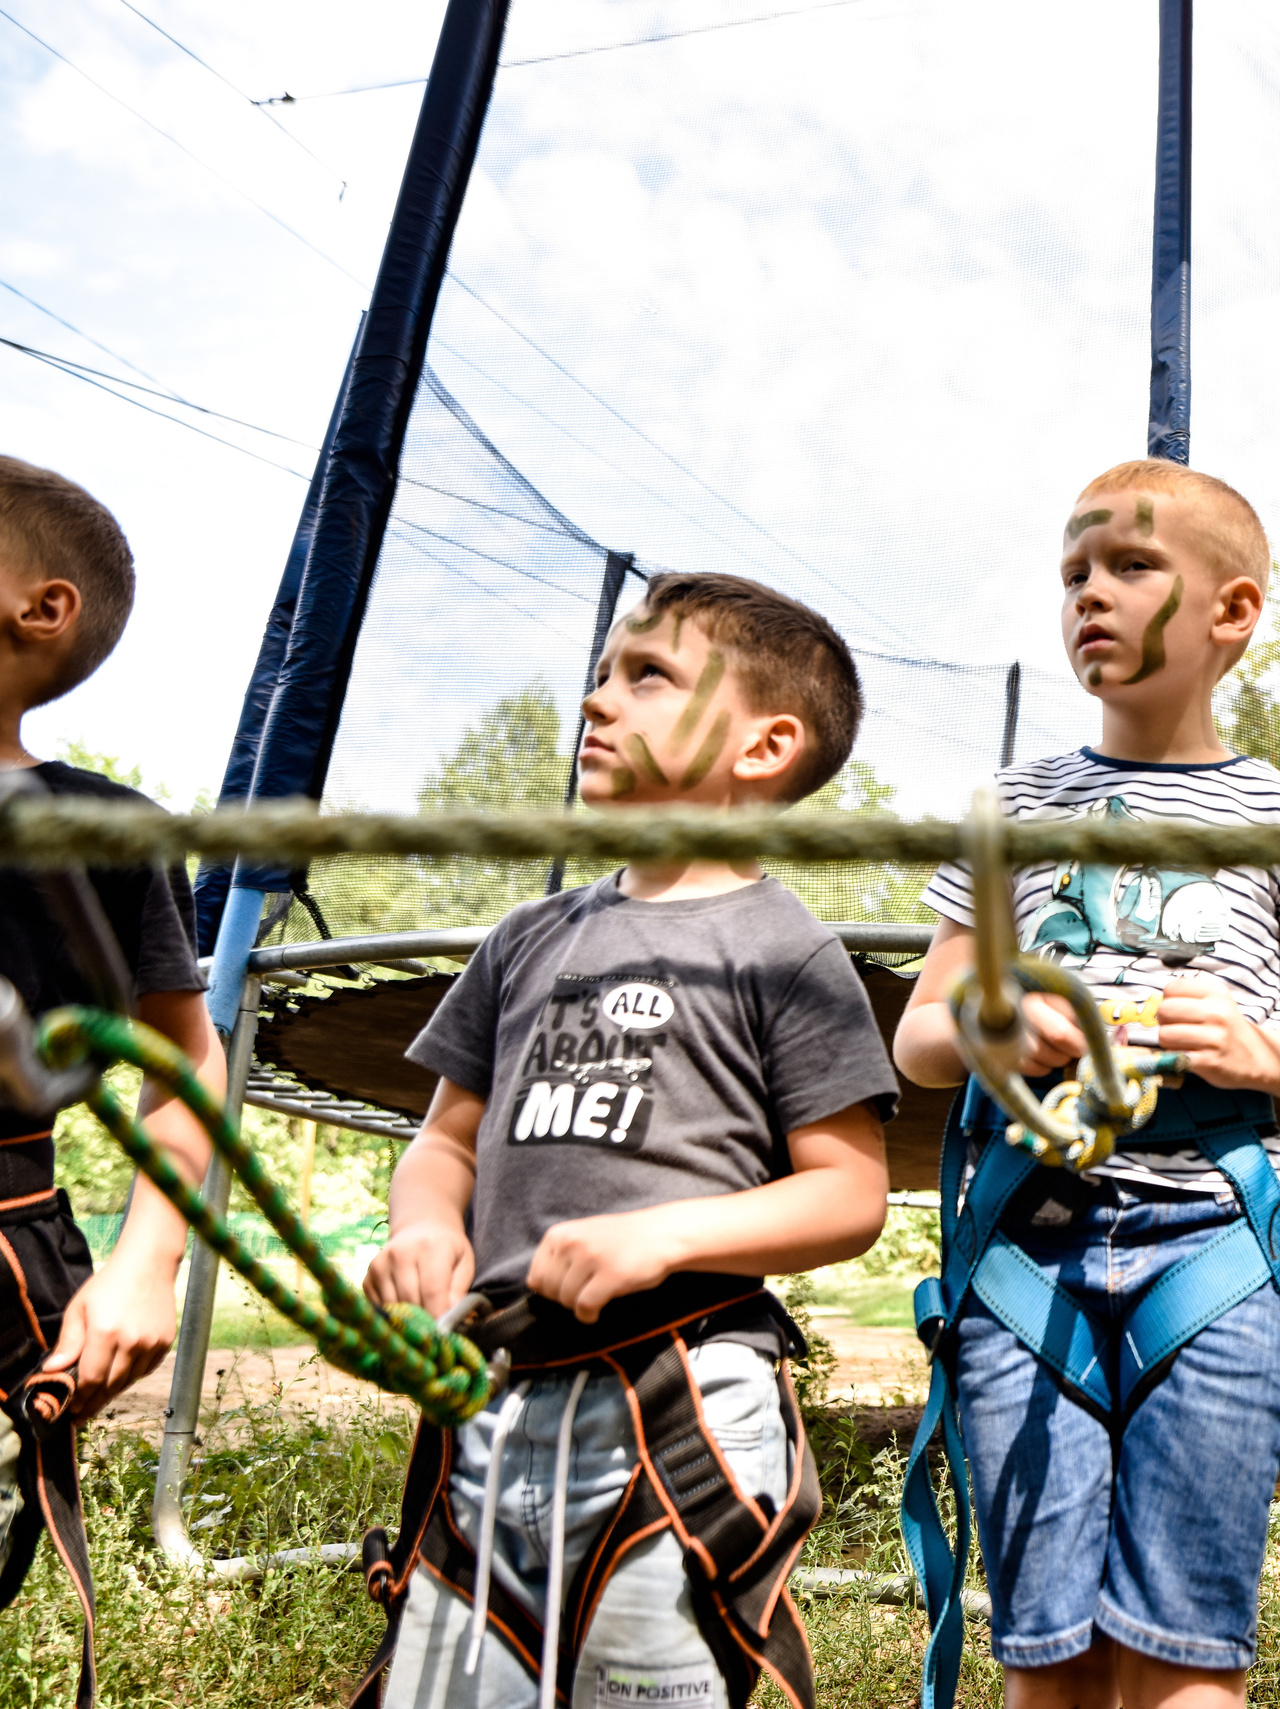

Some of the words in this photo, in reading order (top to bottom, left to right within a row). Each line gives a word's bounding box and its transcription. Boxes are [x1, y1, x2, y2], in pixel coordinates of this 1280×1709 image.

[611, 991, 662, 1019] ALL
[522, 1029, 668, 1077] ABOUT
[514, 1080, 645, 1143] ME!
